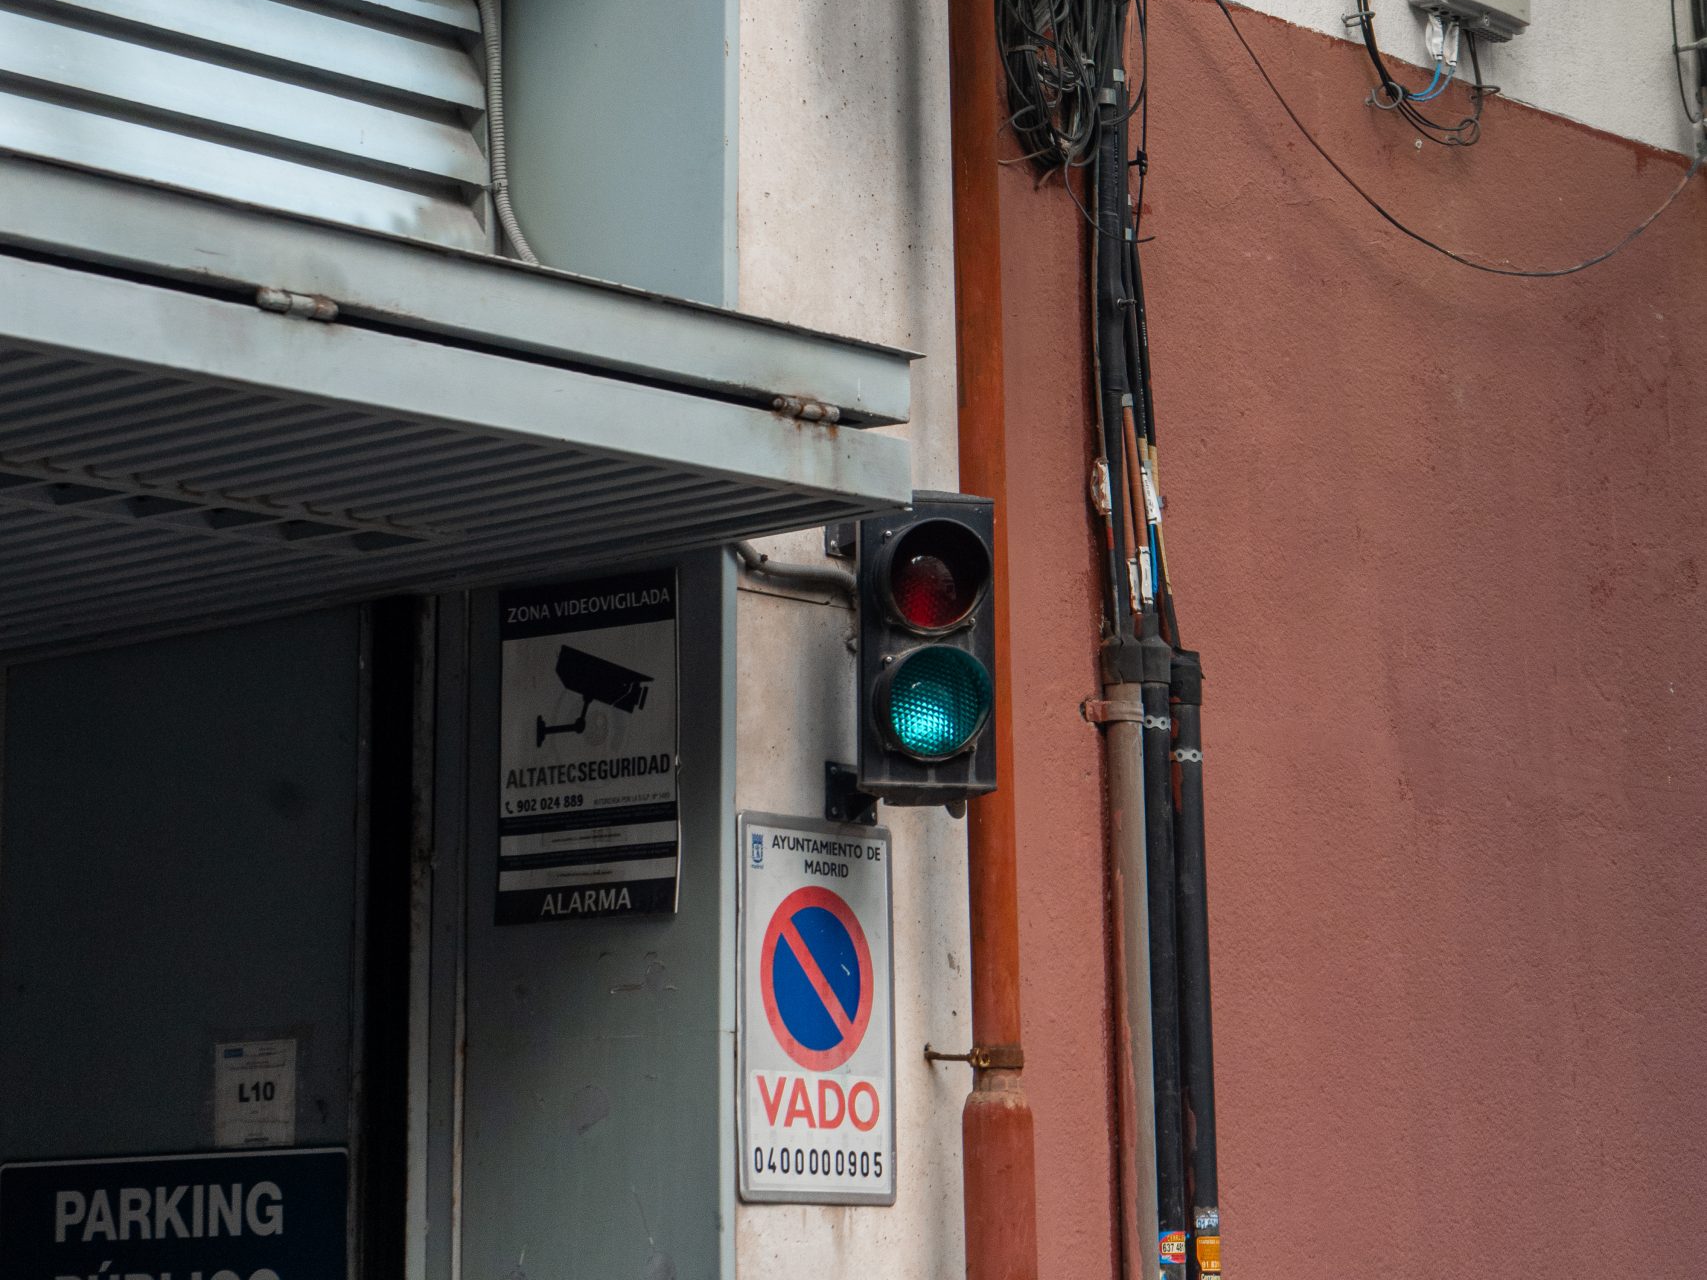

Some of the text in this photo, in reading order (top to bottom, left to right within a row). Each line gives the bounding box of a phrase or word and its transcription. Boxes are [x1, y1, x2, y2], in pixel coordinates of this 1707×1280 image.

[507, 587, 671, 623] ZONA VIDEOVIGILADA
[506, 753, 671, 789] ALTATECSEGURIDAD
[517, 799, 537, 813] 902
[540, 797, 560, 811] 024
[564, 794, 584, 808] 889
[772, 835, 881, 861] AYUNTAMIENTO DE
[804, 859, 849, 878] MADRID
[540, 887, 632, 916] ALARMA
[238, 1081, 275, 1103] L10
[756, 1075, 881, 1132] VADO
[754, 1146, 883, 1178] 0400000905
[55, 1180, 284, 1243] PARKING
